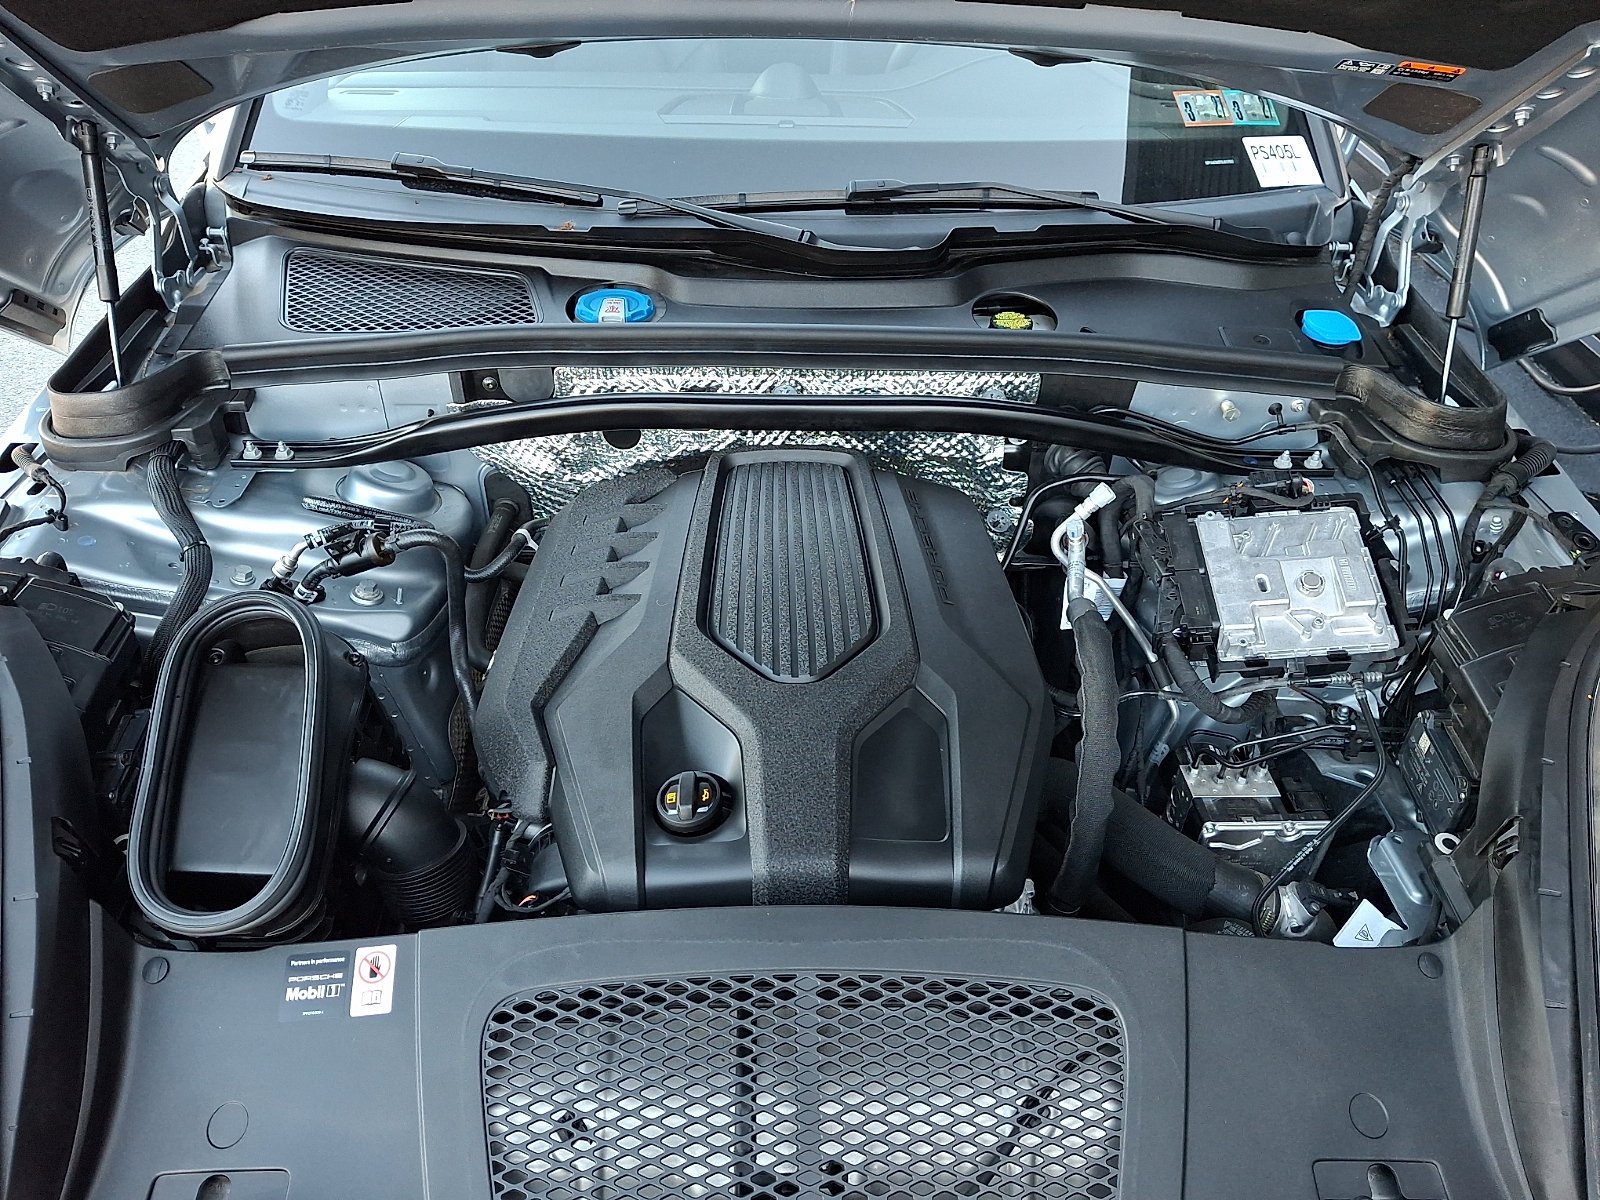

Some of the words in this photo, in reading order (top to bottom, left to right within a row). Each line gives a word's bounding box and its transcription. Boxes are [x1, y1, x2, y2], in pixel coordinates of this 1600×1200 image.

[1183, 101, 1196, 121] 3
[1232, 100, 1244, 121] 3
[1250, 144, 1301, 160] PS405L
[288, 972, 343, 983] PORSCHE
[285, 984, 326, 1002] Mobil
